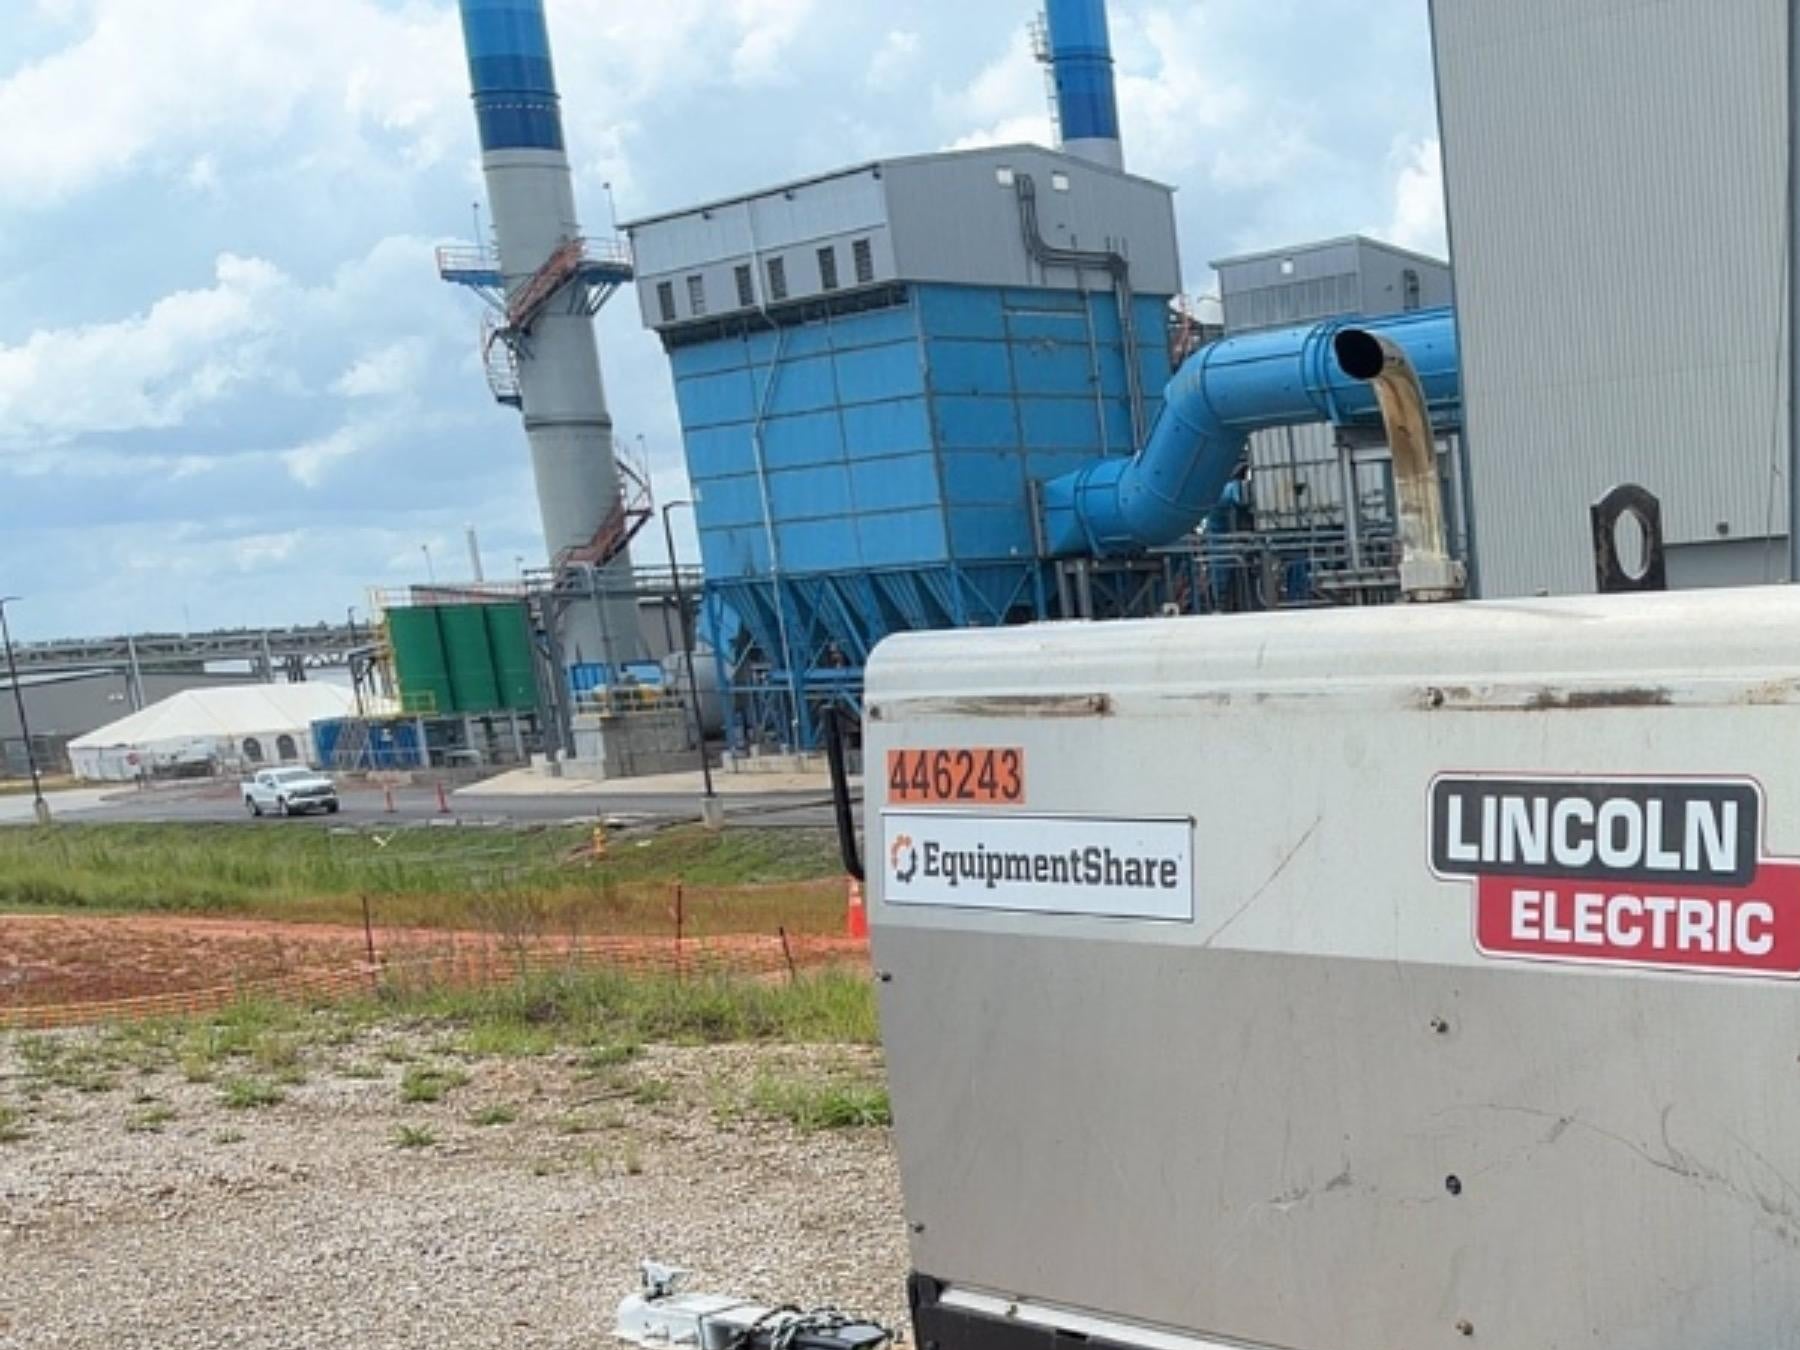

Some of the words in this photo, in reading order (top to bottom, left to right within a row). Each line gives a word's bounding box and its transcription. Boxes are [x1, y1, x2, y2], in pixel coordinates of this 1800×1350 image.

[889, 749, 1022, 800] 446243
[1446, 793, 1739, 873] LINCOLN
[923, 842, 1178, 888] EquipmentShare
[1511, 888, 1775, 956] ELECTRIC
